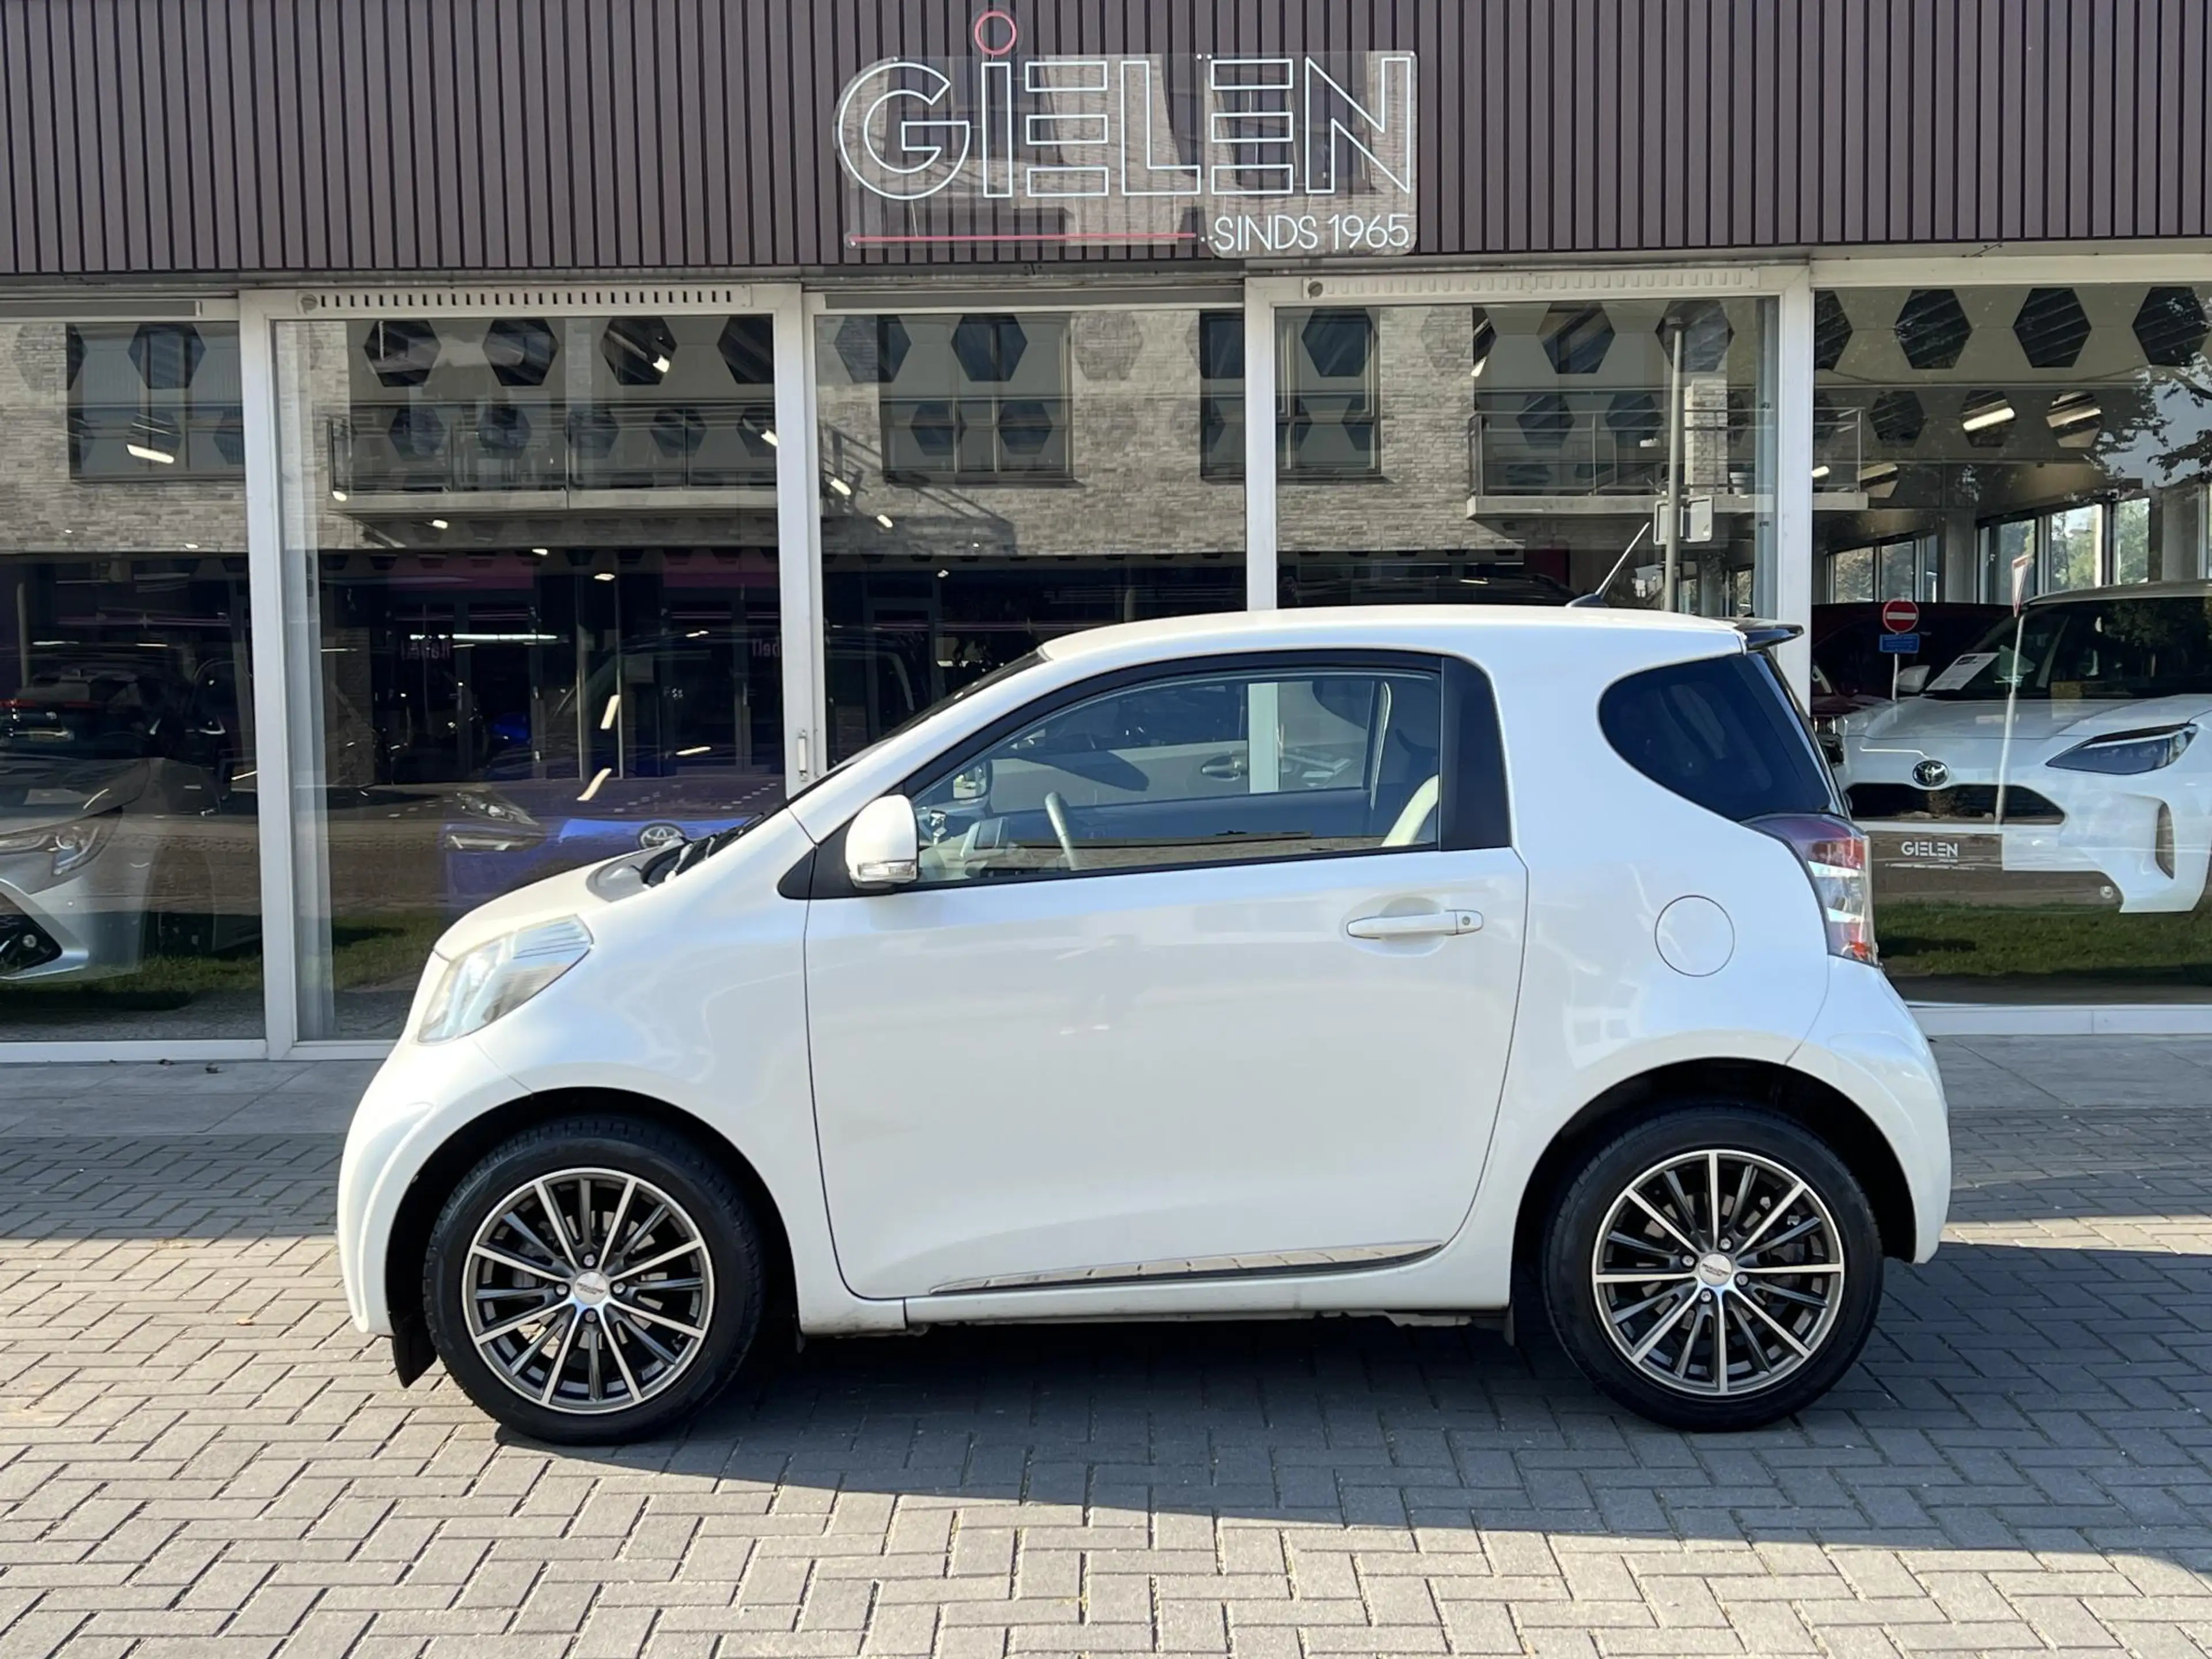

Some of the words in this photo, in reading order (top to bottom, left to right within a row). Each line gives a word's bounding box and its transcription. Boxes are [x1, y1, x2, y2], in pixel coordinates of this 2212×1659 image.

[1214, 215, 1318, 251] SINDS
[1327, 213, 1410, 250] 1965
[1901, 841, 1958, 857] GIELEN
